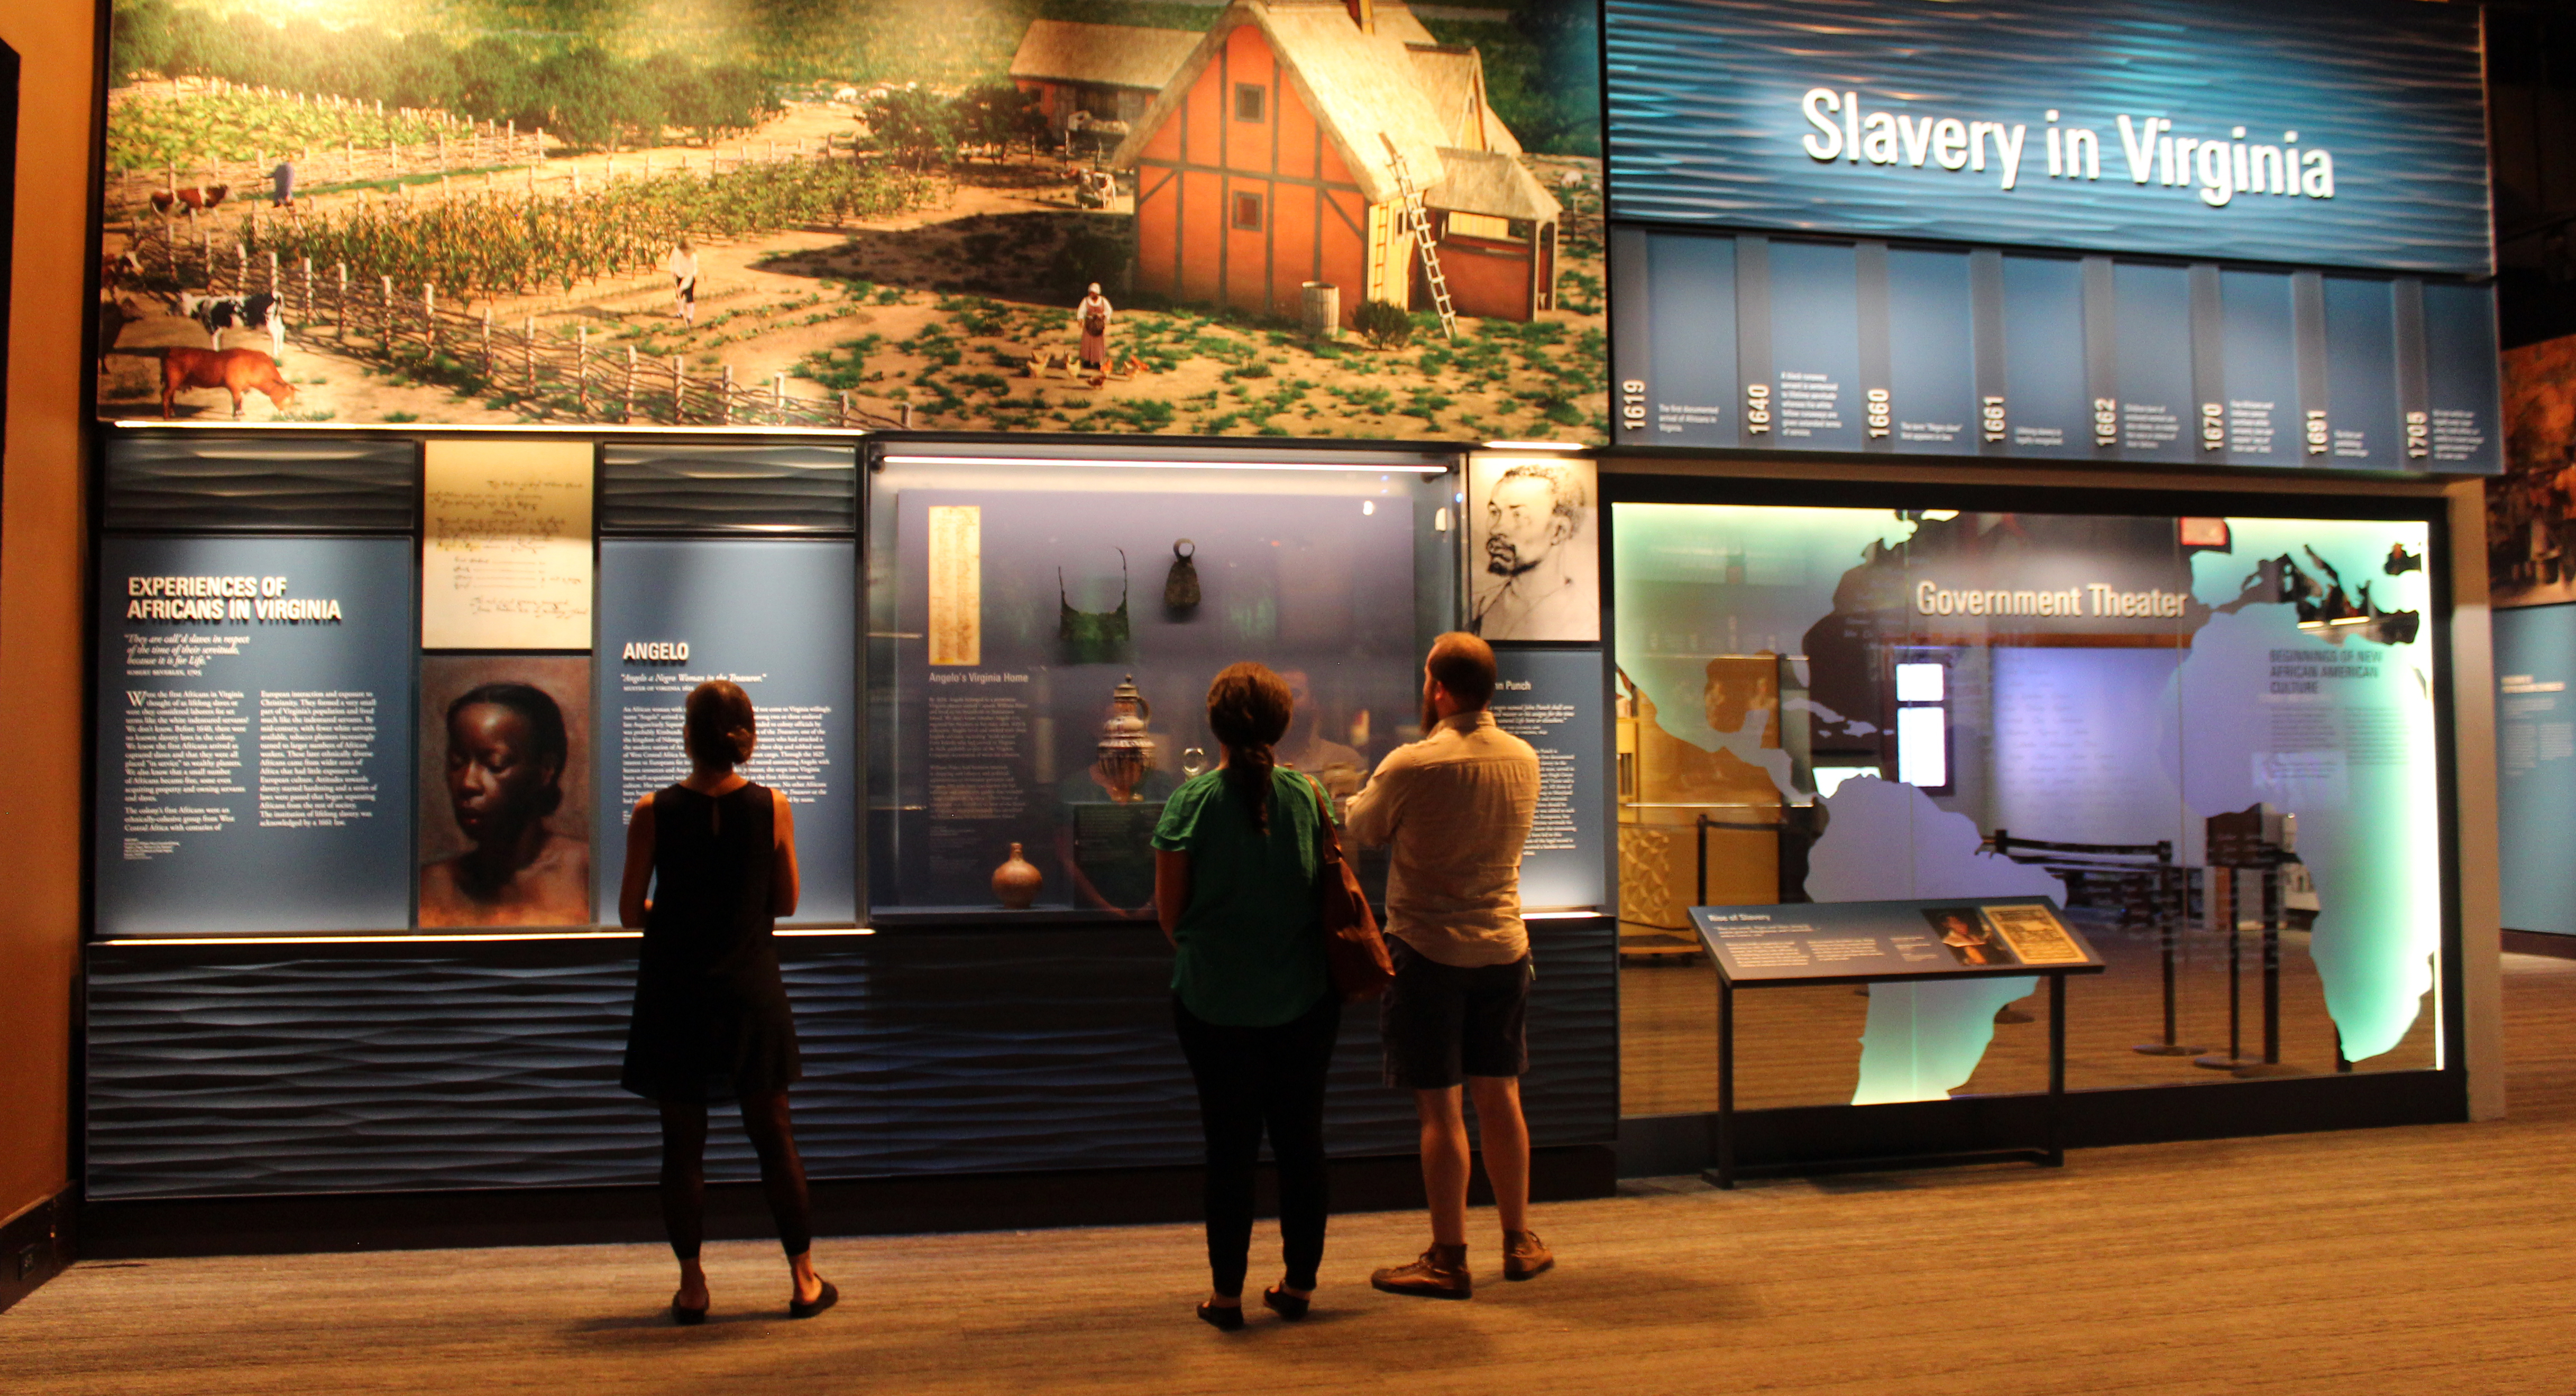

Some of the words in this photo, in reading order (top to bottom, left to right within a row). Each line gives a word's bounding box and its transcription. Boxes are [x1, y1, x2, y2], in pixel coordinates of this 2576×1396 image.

[1802, 87, 2025, 190] Slavery
[2045, 108, 2100, 180] in
[2117, 114, 2335, 207] Virginia
[1622, 379, 1647, 431] 1619
[1747, 383, 1771, 435] 1640
[1867, 388, 1890, 439] 1660
[1983, 396, 2006, 443] 1661
[2094, 398, 2117, 446] 1662
[2202, 402, 2225, 451] 1670
[2306, 410, 2329, 455] 1691
[2406, 411, 2429, 459] 1705
[128, 576, 258, 598] EXPERIENCES
[261, 576, 287, 598] OF
[1916, 580, 2083, 617] Government
[2087, 582, 2188, 618] Theater
[127, 599, 224, 620] AFRICANS
[228, 599, 251, 620] IN
[254, 599, 342, 620] VIRGINIA
[224, 636, 250, 646] respect
[126, 646, 135, 656] of
[171, 646, 180, 656] of
[622, 641, 689, 660] ANGELO
[2269, 649, 2336, 663] BEGINNINGS
[2340, 650, 2354, 663] OF
[2357, 650, 2383, 663] NEW
[176, 656, 187, 667] for
[655, 674, 676, 684] Negro
[929, 672, 966, 684] Angelo's
[969, 672, 1001, 684] Virginia
[1003, 673, 1029, 683] Home
[2270, 665, 2318, 678] AFRICAN
[2320, 666, 2378, 678] AMERICAN
[1505, 679, 1533, 691] Punch
[2270, 681, 2318, 694] CULTURE
[219, 691, 244, 700] Virginia
[261, 690, 290, 699] European
[300, 699, 316, 708] They
[312, 708, 345, 717] population
